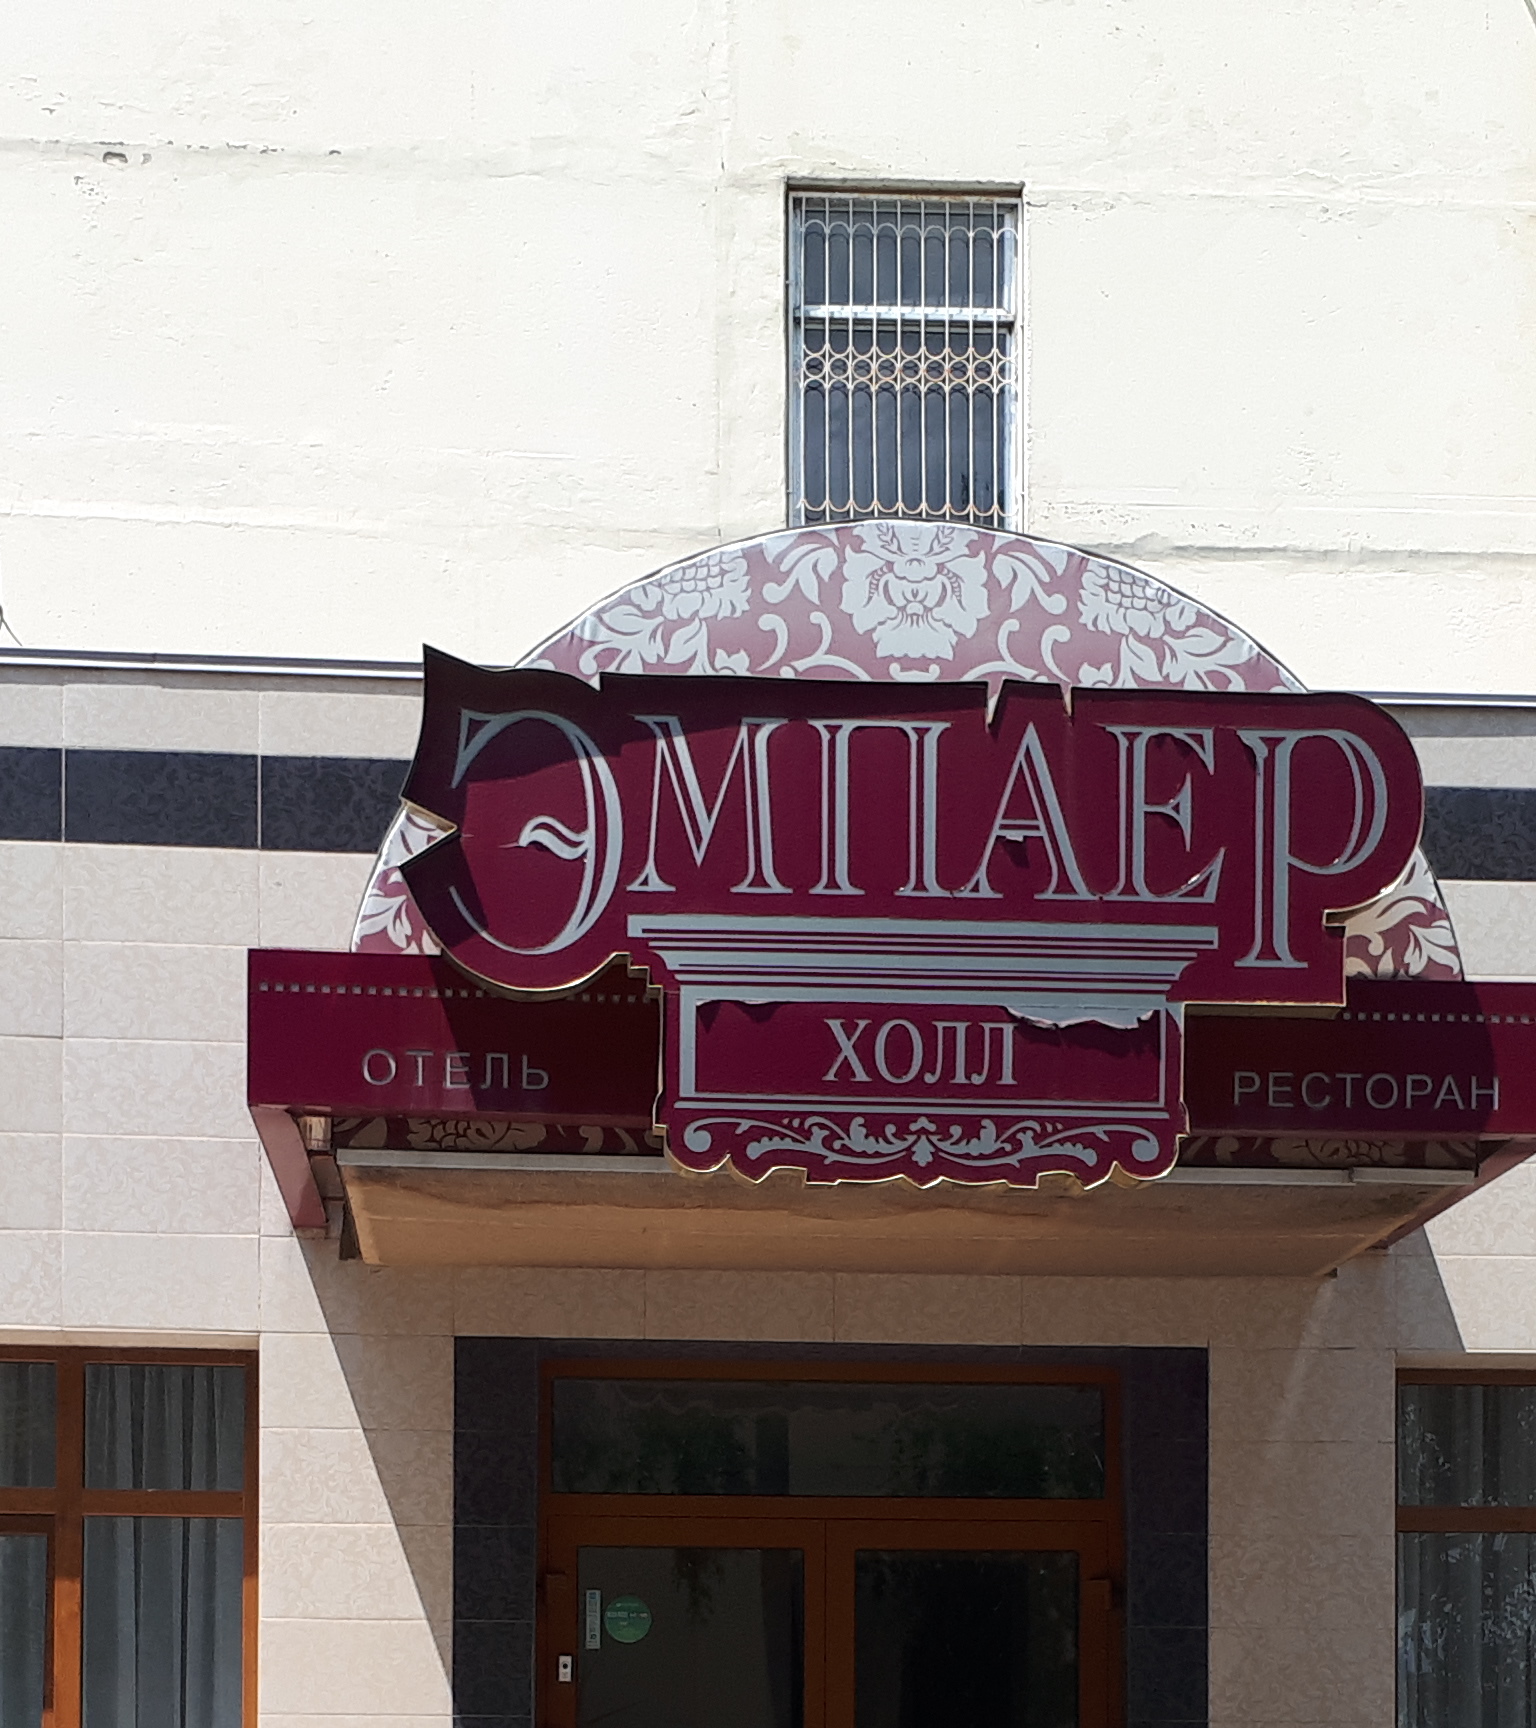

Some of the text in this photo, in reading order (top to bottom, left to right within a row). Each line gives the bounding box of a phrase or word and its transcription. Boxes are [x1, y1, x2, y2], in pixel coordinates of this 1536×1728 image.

[450, 708, 1388, 969] ЭМПАЕР
[362, 1048, 550, 1090] ОТЕЛЬ
[821, 1018, 1018, 1085] ХОЛЛ
[1232, 1070, 1500, 1111] РЕСТОРАН
